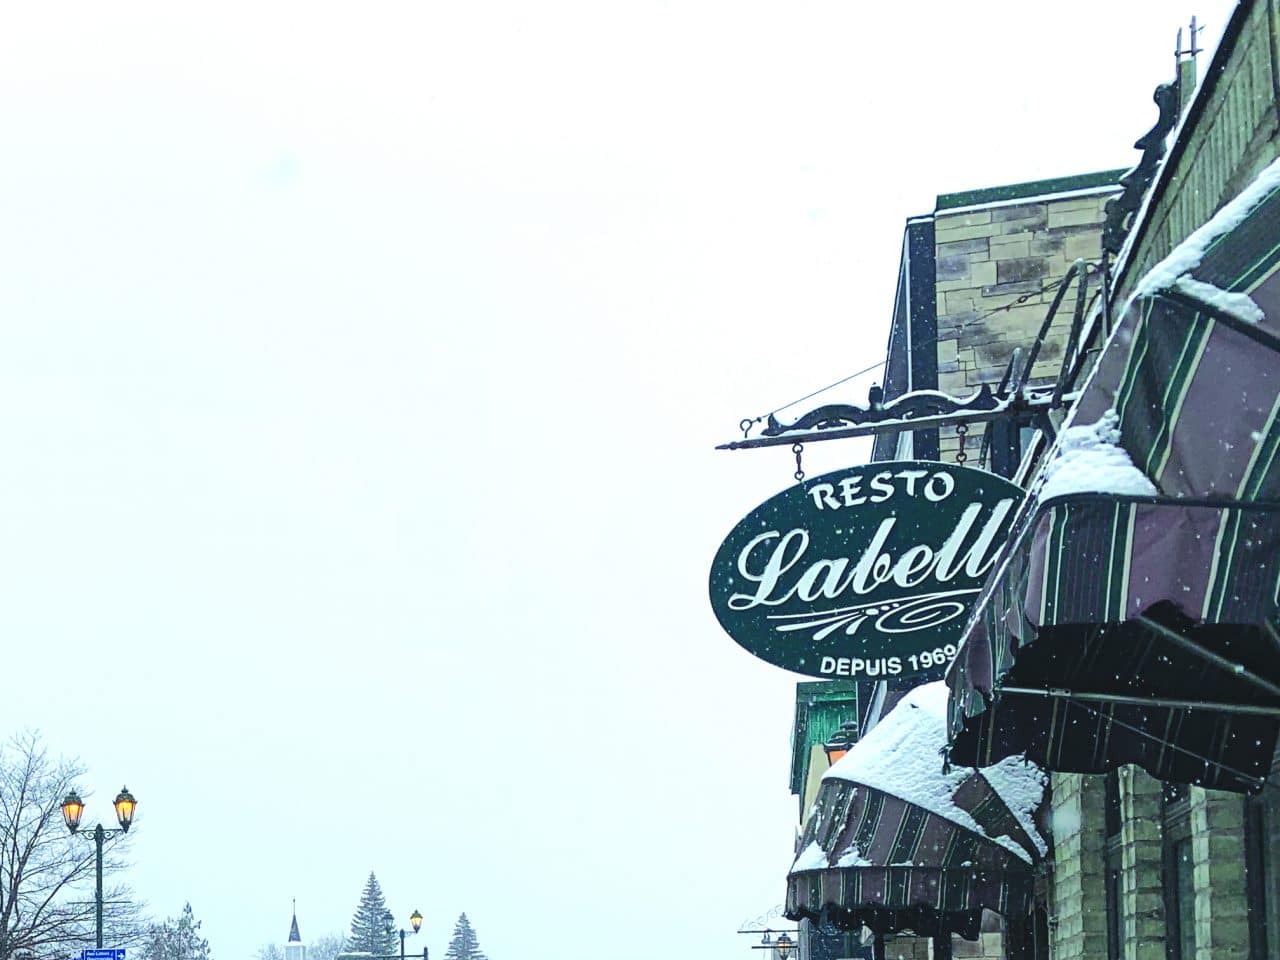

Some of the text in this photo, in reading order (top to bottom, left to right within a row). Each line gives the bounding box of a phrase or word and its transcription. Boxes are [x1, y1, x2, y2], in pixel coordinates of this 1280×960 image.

[808, 470, 955, 510] RESTO
[728, 498, 1014, 611] Labell
[820, 644, 956, 676] DEPUIS 1969
